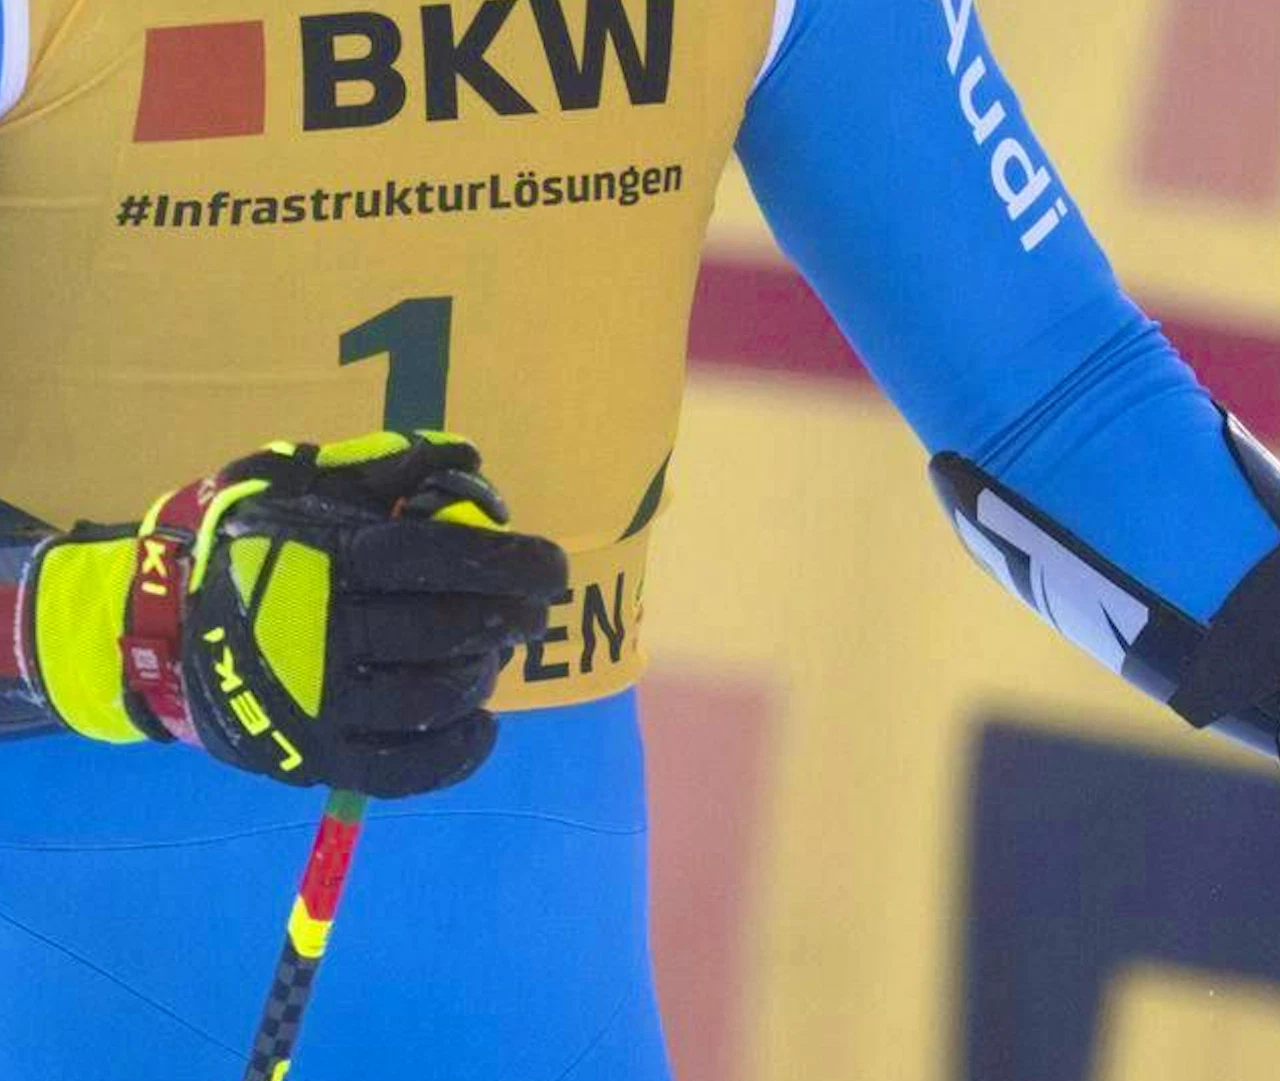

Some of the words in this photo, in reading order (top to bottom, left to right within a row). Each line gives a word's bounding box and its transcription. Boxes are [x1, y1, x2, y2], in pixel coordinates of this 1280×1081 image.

[115, 162, 683, 229] #InfrastrukturLösungen
[339, 295, 453, 434] 1
[202, 626, 303, 772] LEKI
